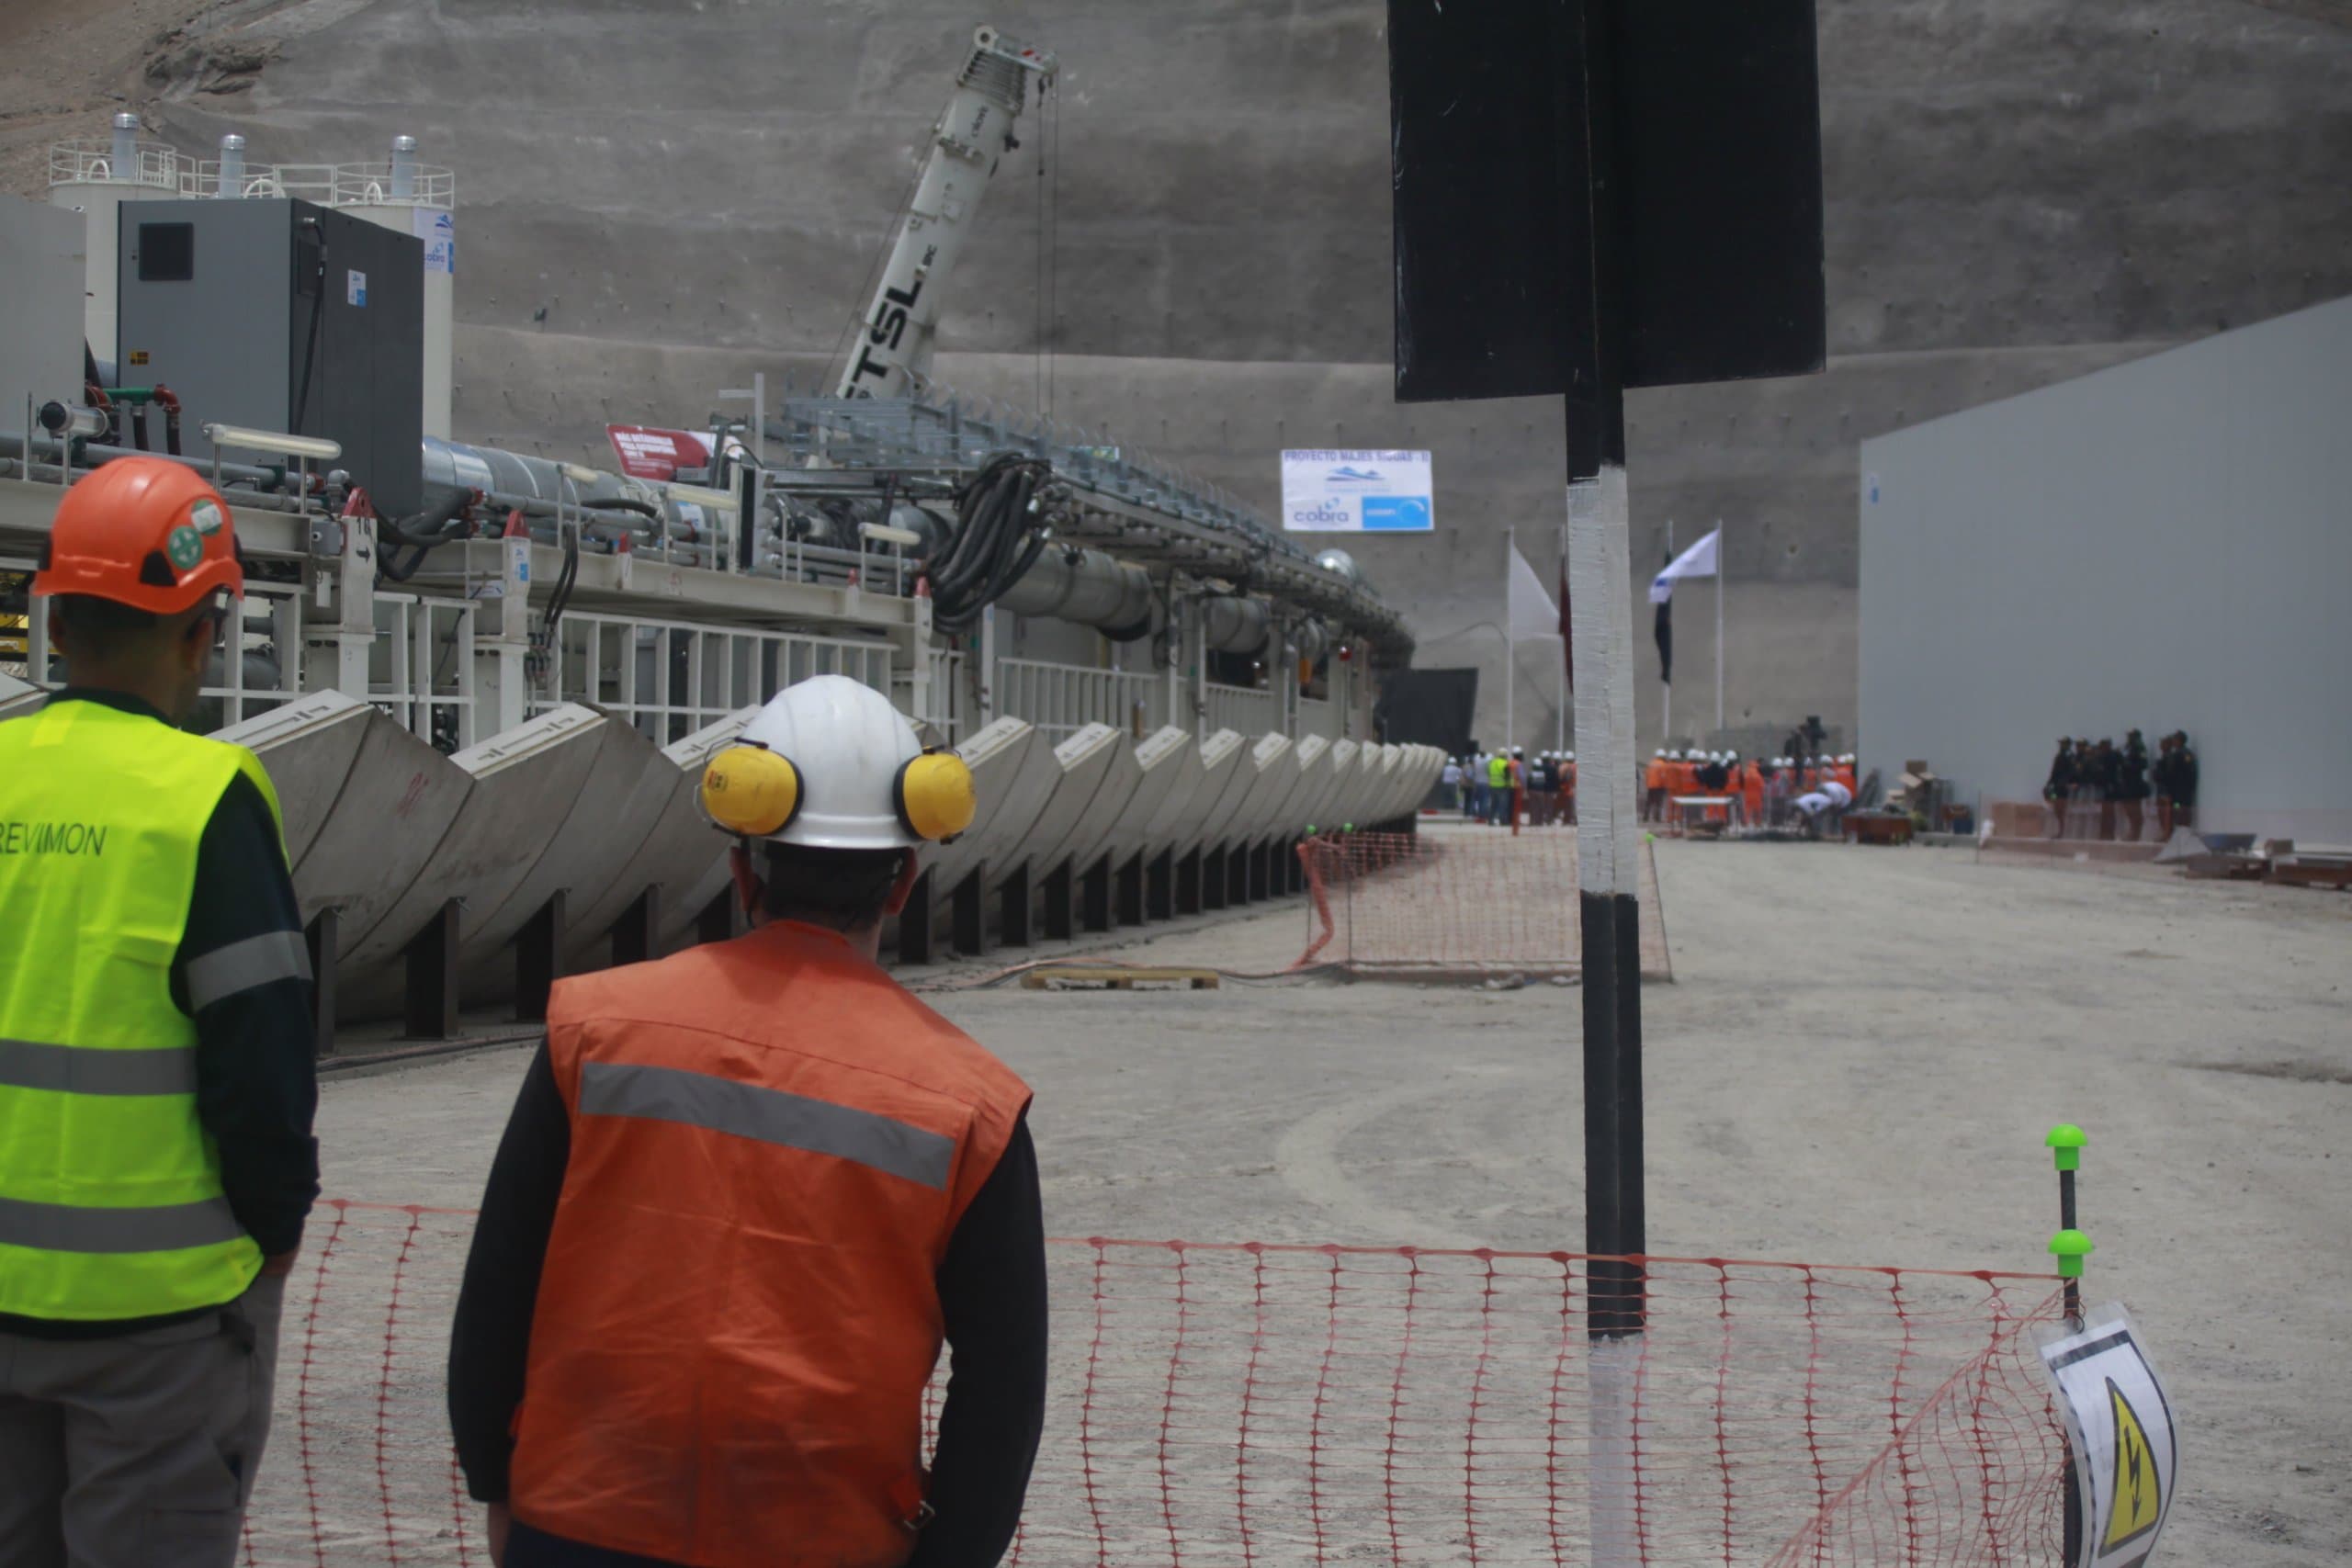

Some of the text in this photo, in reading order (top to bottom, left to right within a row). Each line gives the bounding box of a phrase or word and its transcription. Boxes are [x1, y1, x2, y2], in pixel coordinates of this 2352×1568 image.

[1284, 449, 1338, 463] PROYECTO
[1340, 449, 1374, 463] MAJES
[1294, 503, 1350, 523] cobra
